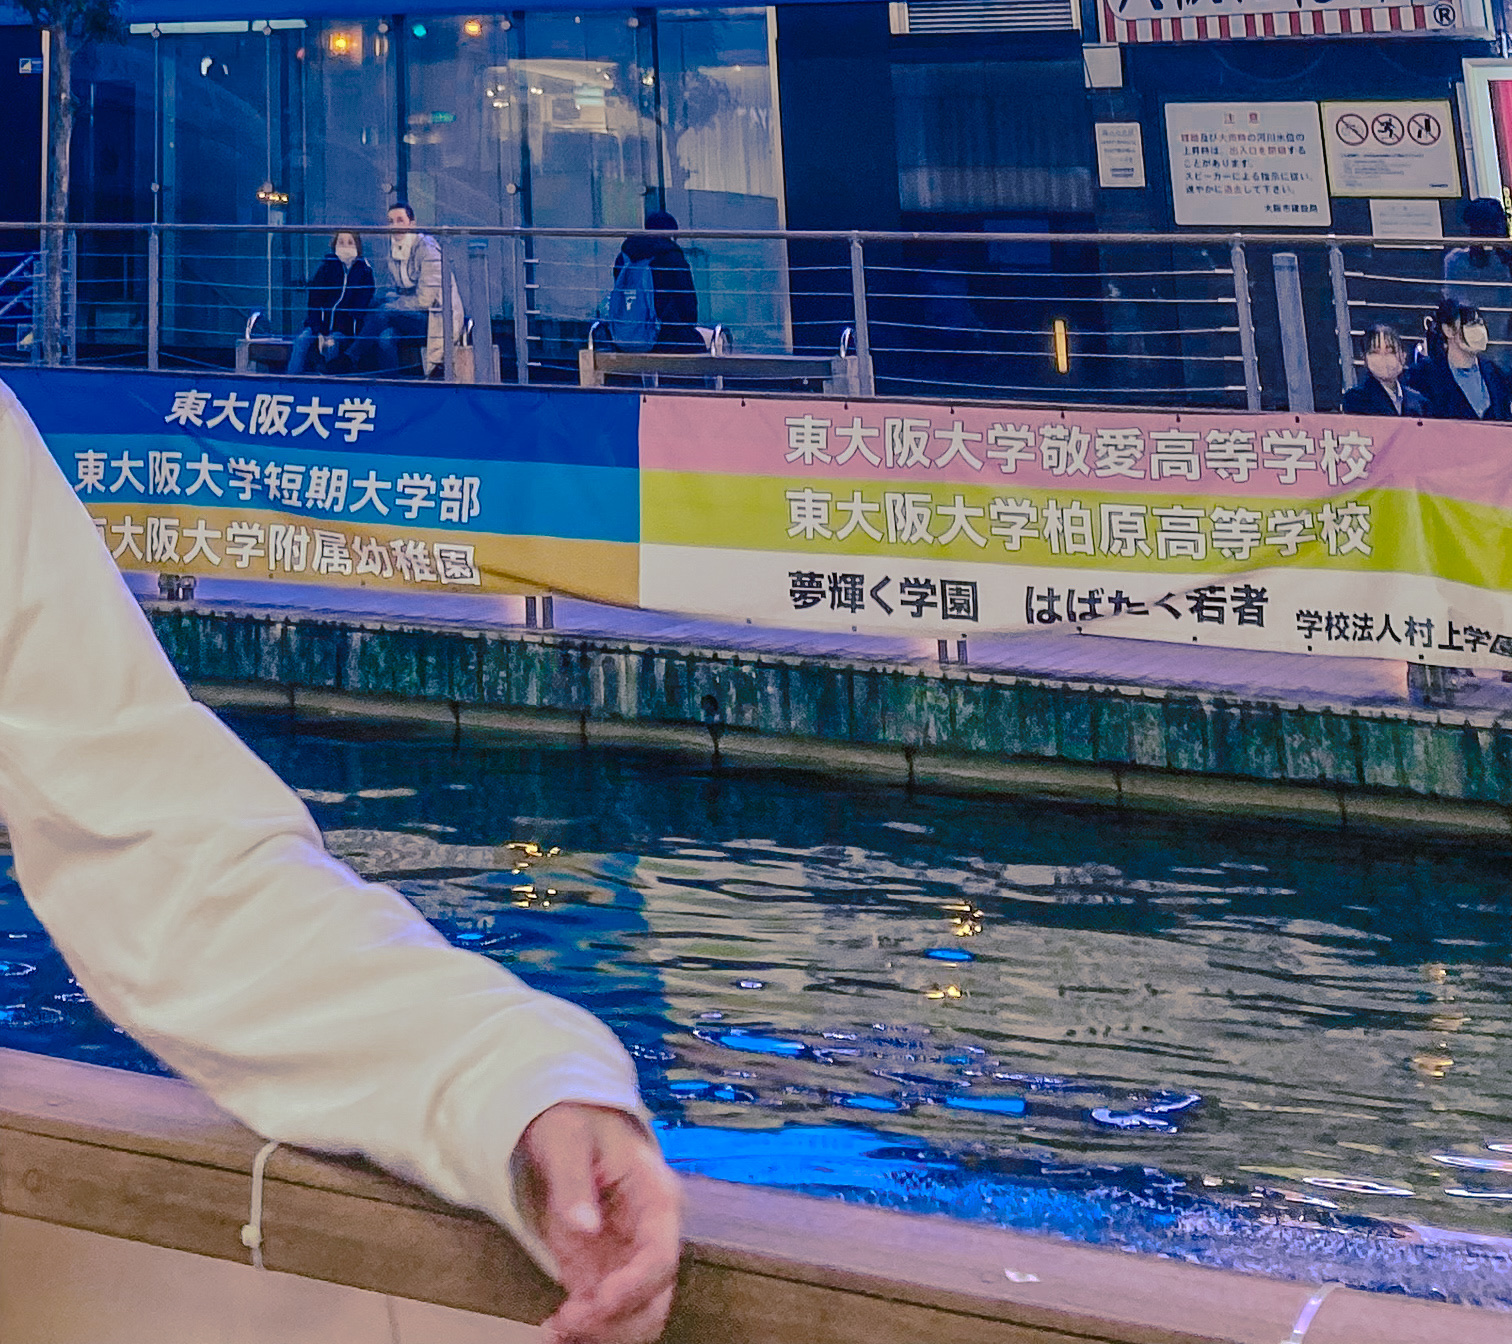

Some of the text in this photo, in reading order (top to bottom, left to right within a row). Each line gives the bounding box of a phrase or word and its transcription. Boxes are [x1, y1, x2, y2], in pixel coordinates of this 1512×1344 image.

[164, 389, 377, 443] 東大阪大学
[784, 413, 1376, 487] 東大阪大学敬愛高等学校
[74, 449, 483, 524] 東大阪大学短期大学部
[784, 488, 1374, 562] 東大阪大学柏原高等学校
[787, 570, 1270, 630] 夢輝く学園 はばたく若者
